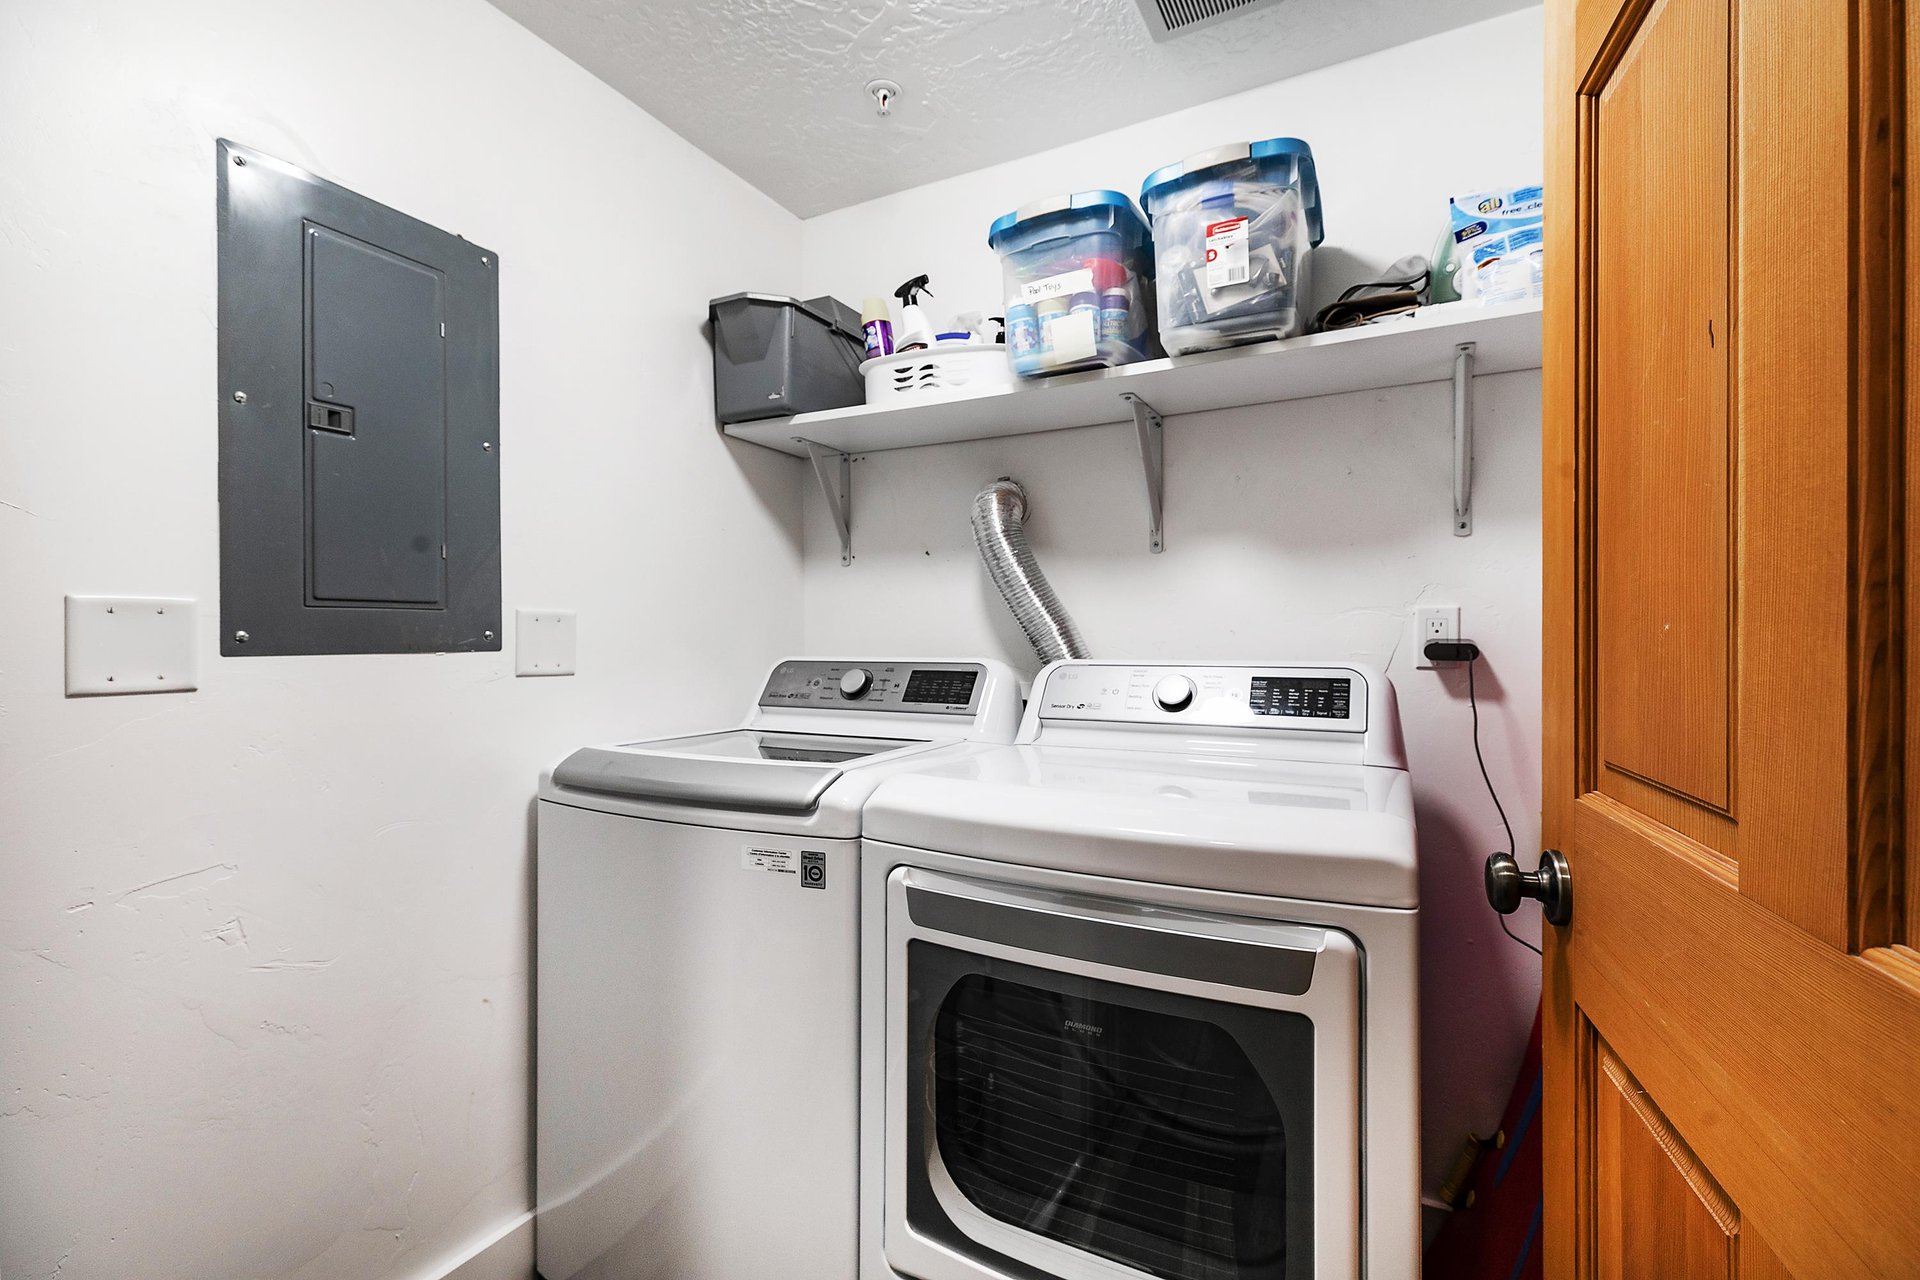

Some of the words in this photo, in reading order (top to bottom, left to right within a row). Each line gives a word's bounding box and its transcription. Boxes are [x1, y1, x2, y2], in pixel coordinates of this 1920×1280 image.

[1480, 198, 1501, 213] all
[1502, 207, 1521, 215] free
[1029, 285, 1041, 296] Pool
[1043, 283, 1062, 293] Toys
[1065, 1020, 1103, 1034] DIAMOND
